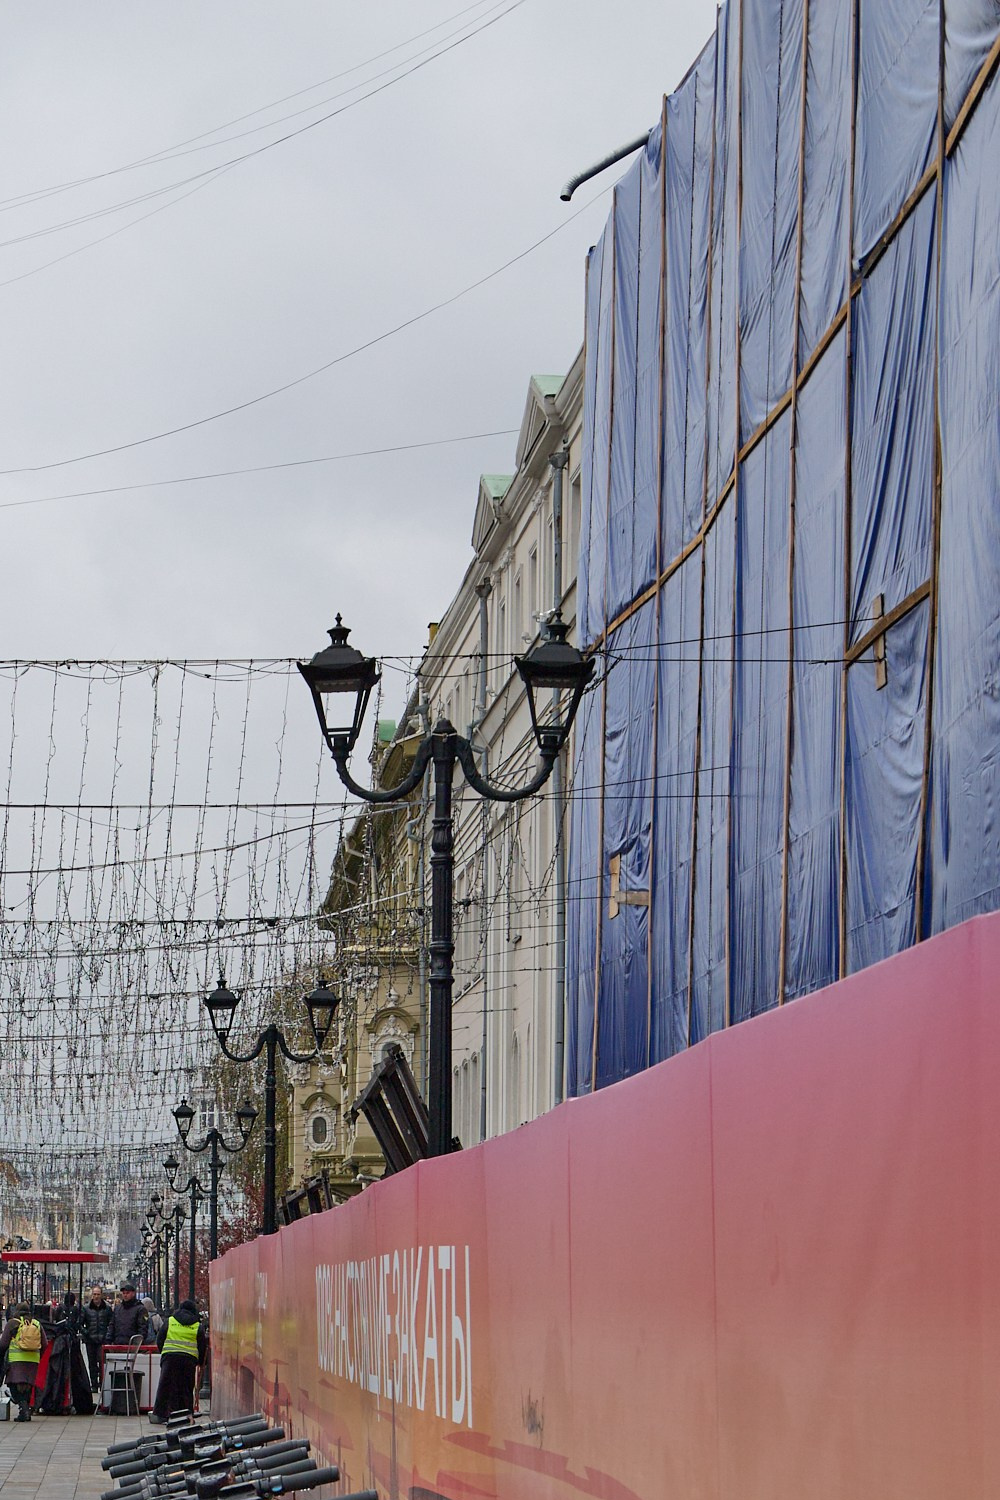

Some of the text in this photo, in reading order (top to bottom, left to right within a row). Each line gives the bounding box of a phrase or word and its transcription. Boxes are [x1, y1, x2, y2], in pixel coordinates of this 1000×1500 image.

[315, 1245, 473, 1429] 100% НАСТОЯЩИЕ ЗАКАТЫ
